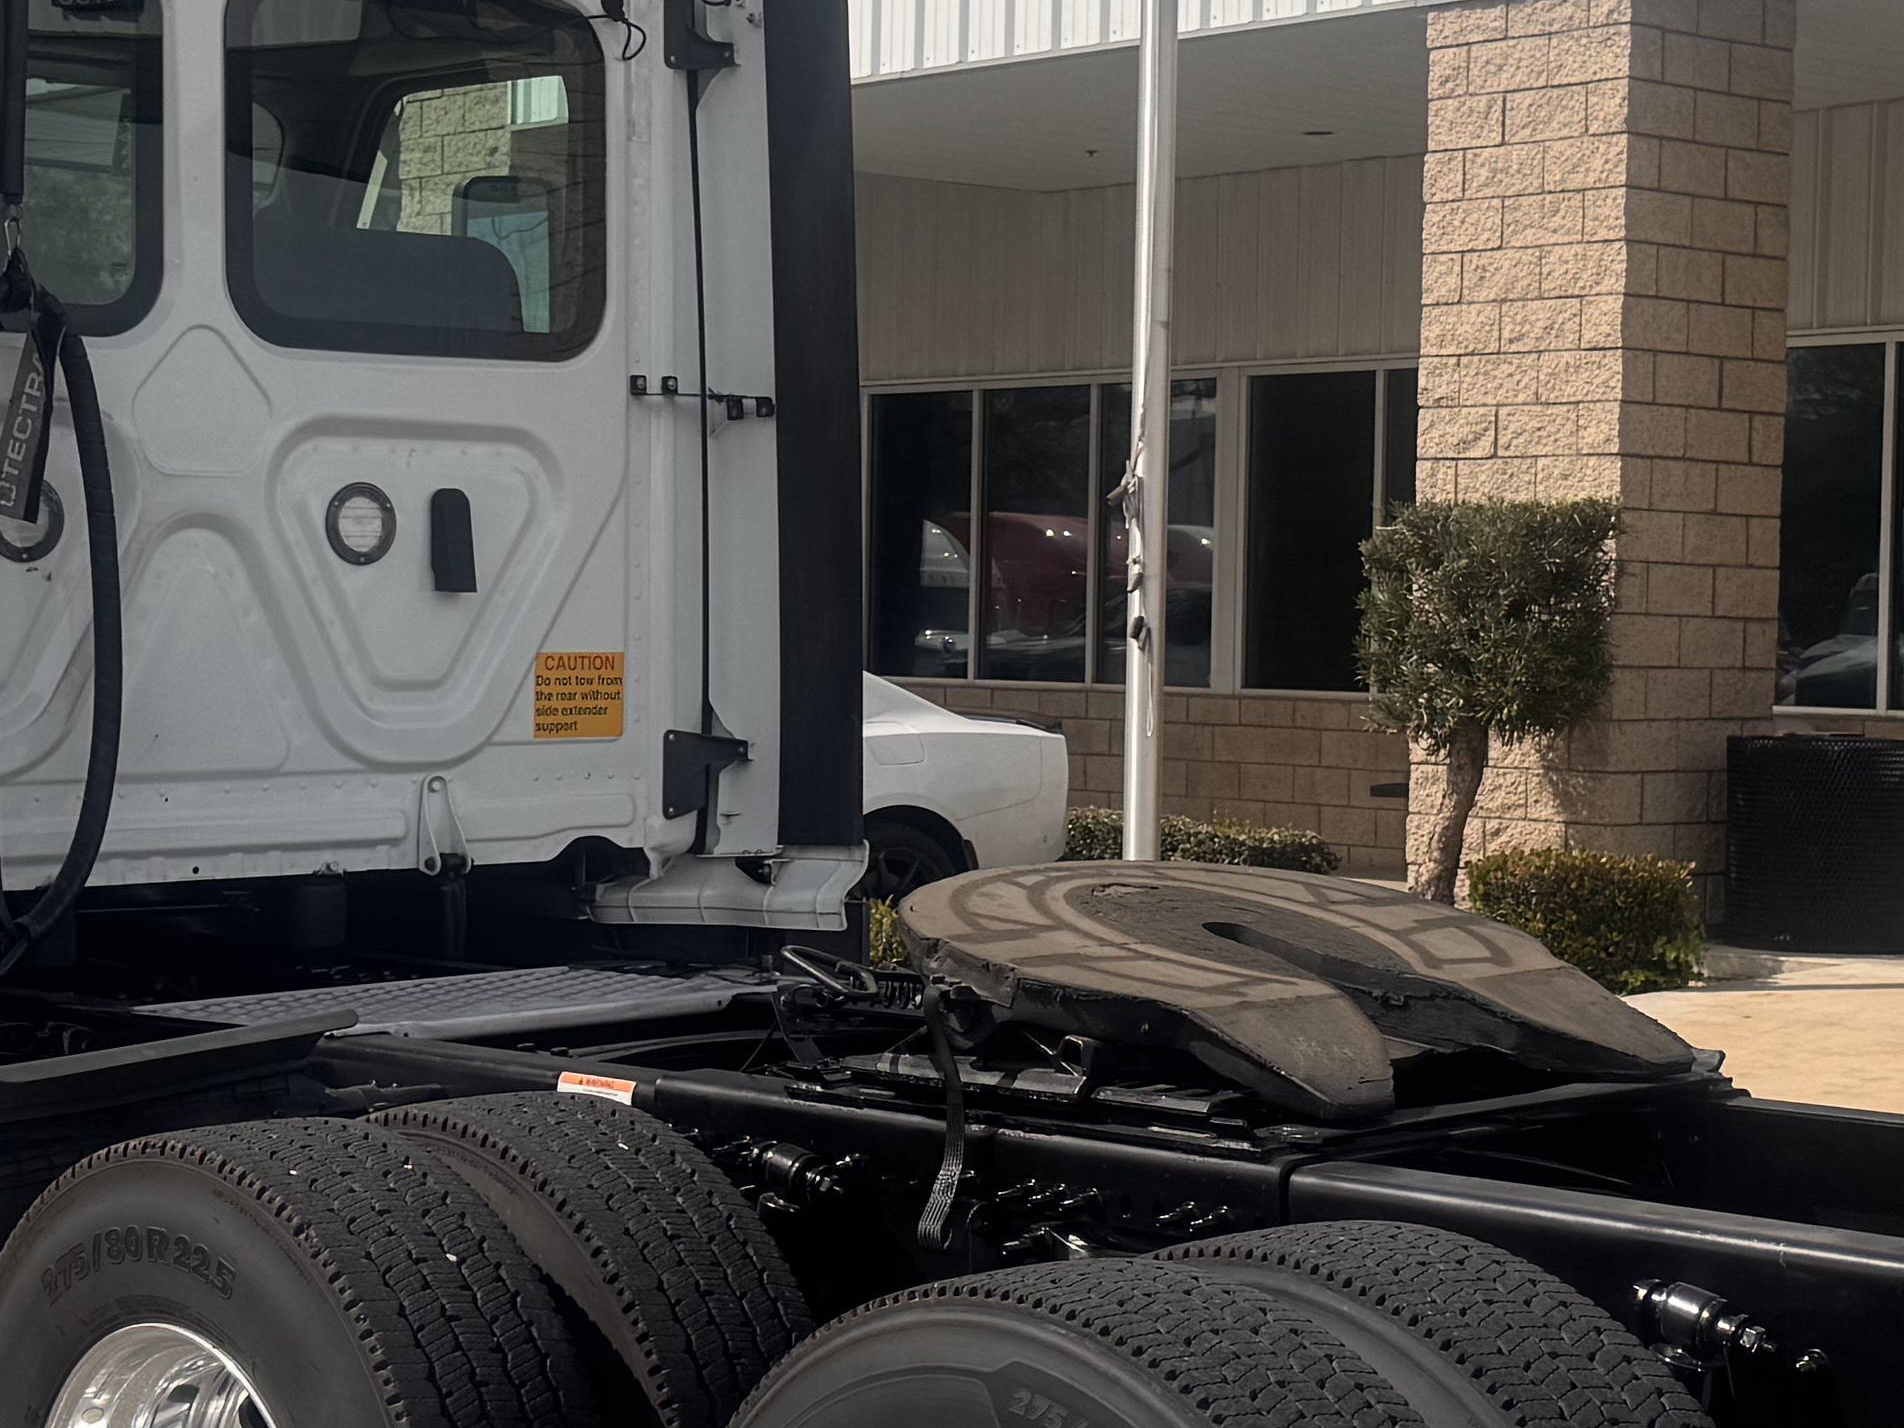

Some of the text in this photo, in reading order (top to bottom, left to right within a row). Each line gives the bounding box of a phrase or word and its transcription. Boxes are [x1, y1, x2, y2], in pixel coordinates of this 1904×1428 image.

[545, 655, 615, 671] CAUTION
[536, 675, 623, 686] Do not tow from
[536, 690, 621, 701] the rear without
[535, 705, 608, 716] side extender
[535, 720, 578, 735] support
